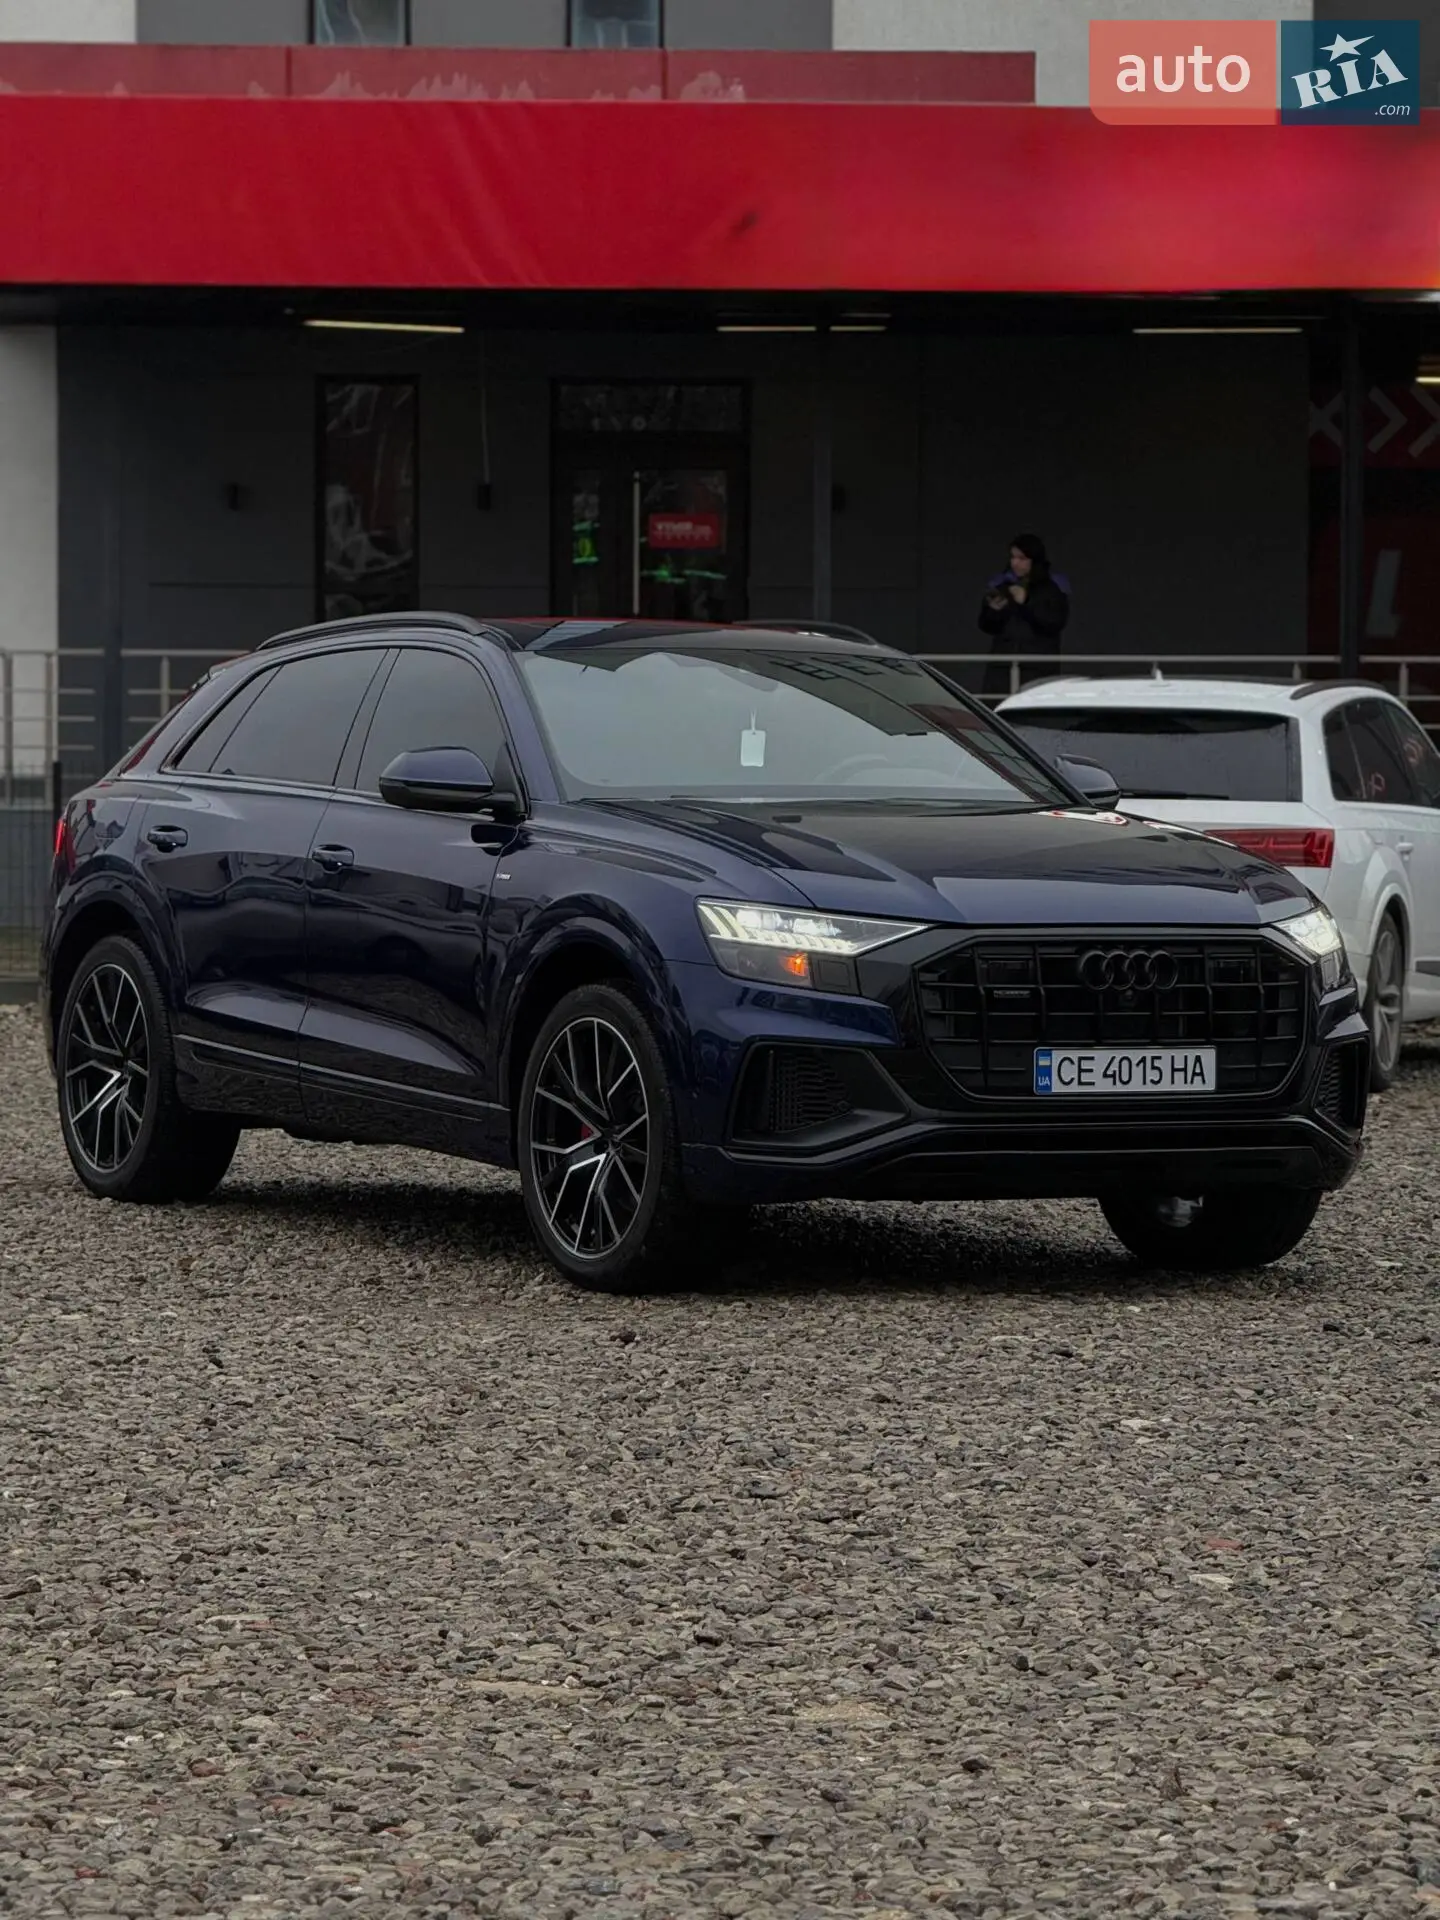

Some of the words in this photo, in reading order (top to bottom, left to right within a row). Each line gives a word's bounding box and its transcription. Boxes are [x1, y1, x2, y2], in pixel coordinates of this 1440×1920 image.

[1057, 1055, 1096, 1087] CE
[1102, 1055, 1164, 1086] 4015
[1170, 1054, 1207, 1085] HA
[1038, 1077, 1051, 1086] UA
